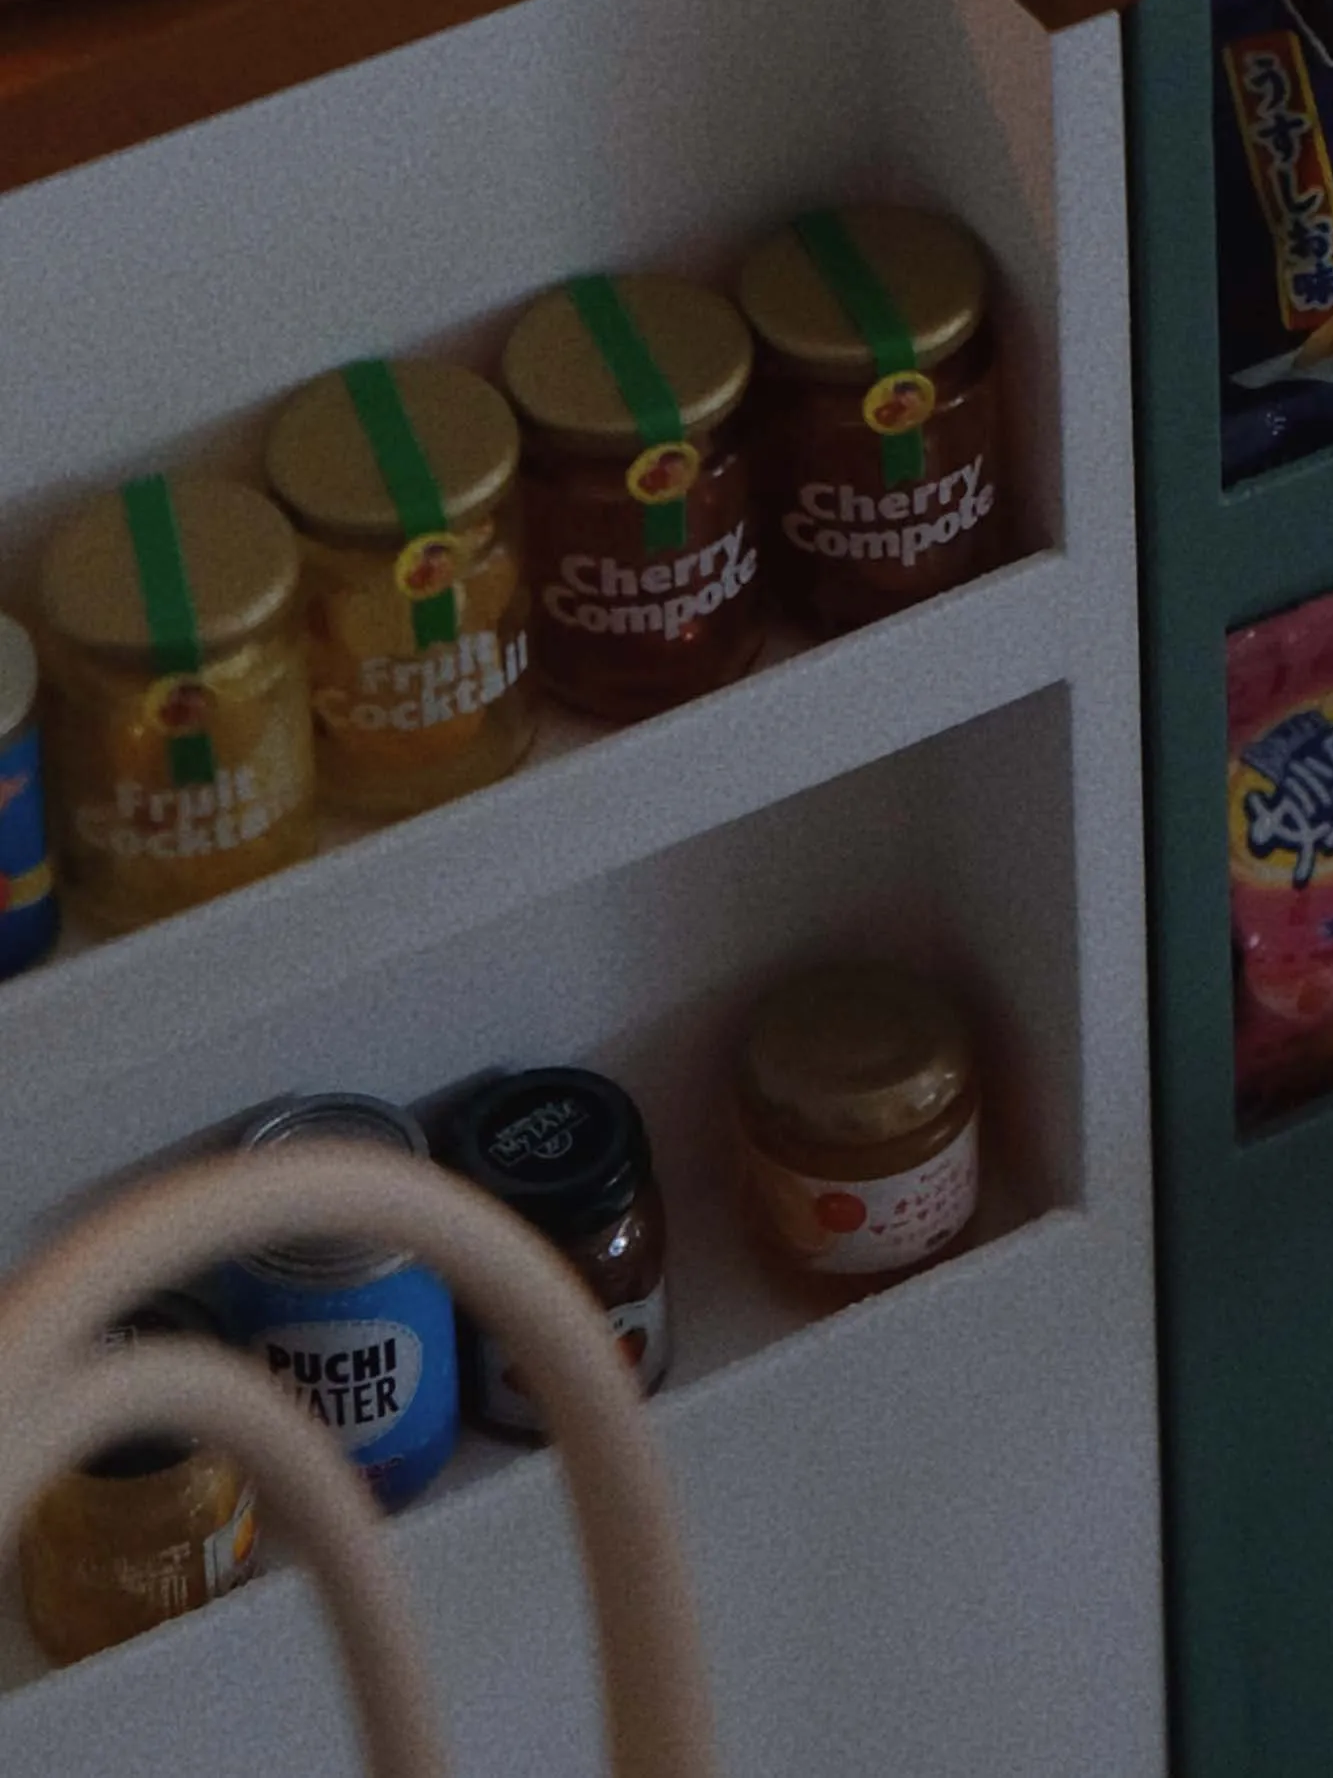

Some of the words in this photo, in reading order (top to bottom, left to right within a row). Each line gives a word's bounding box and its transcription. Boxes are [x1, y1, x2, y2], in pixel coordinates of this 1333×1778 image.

[800, 454, 984, 521] Cherry
[561, 520, 745, 596] Cherry
[781, 482, 995, 566] Compote
[543, 547, 757, 641] Compote
[314, 629, 528, 732] Cocktail
[360, 631, 498, 694] Fruit
[115, 765, 255, 821] Fruit
[268, 1338, 396, 1384] PUCHI
